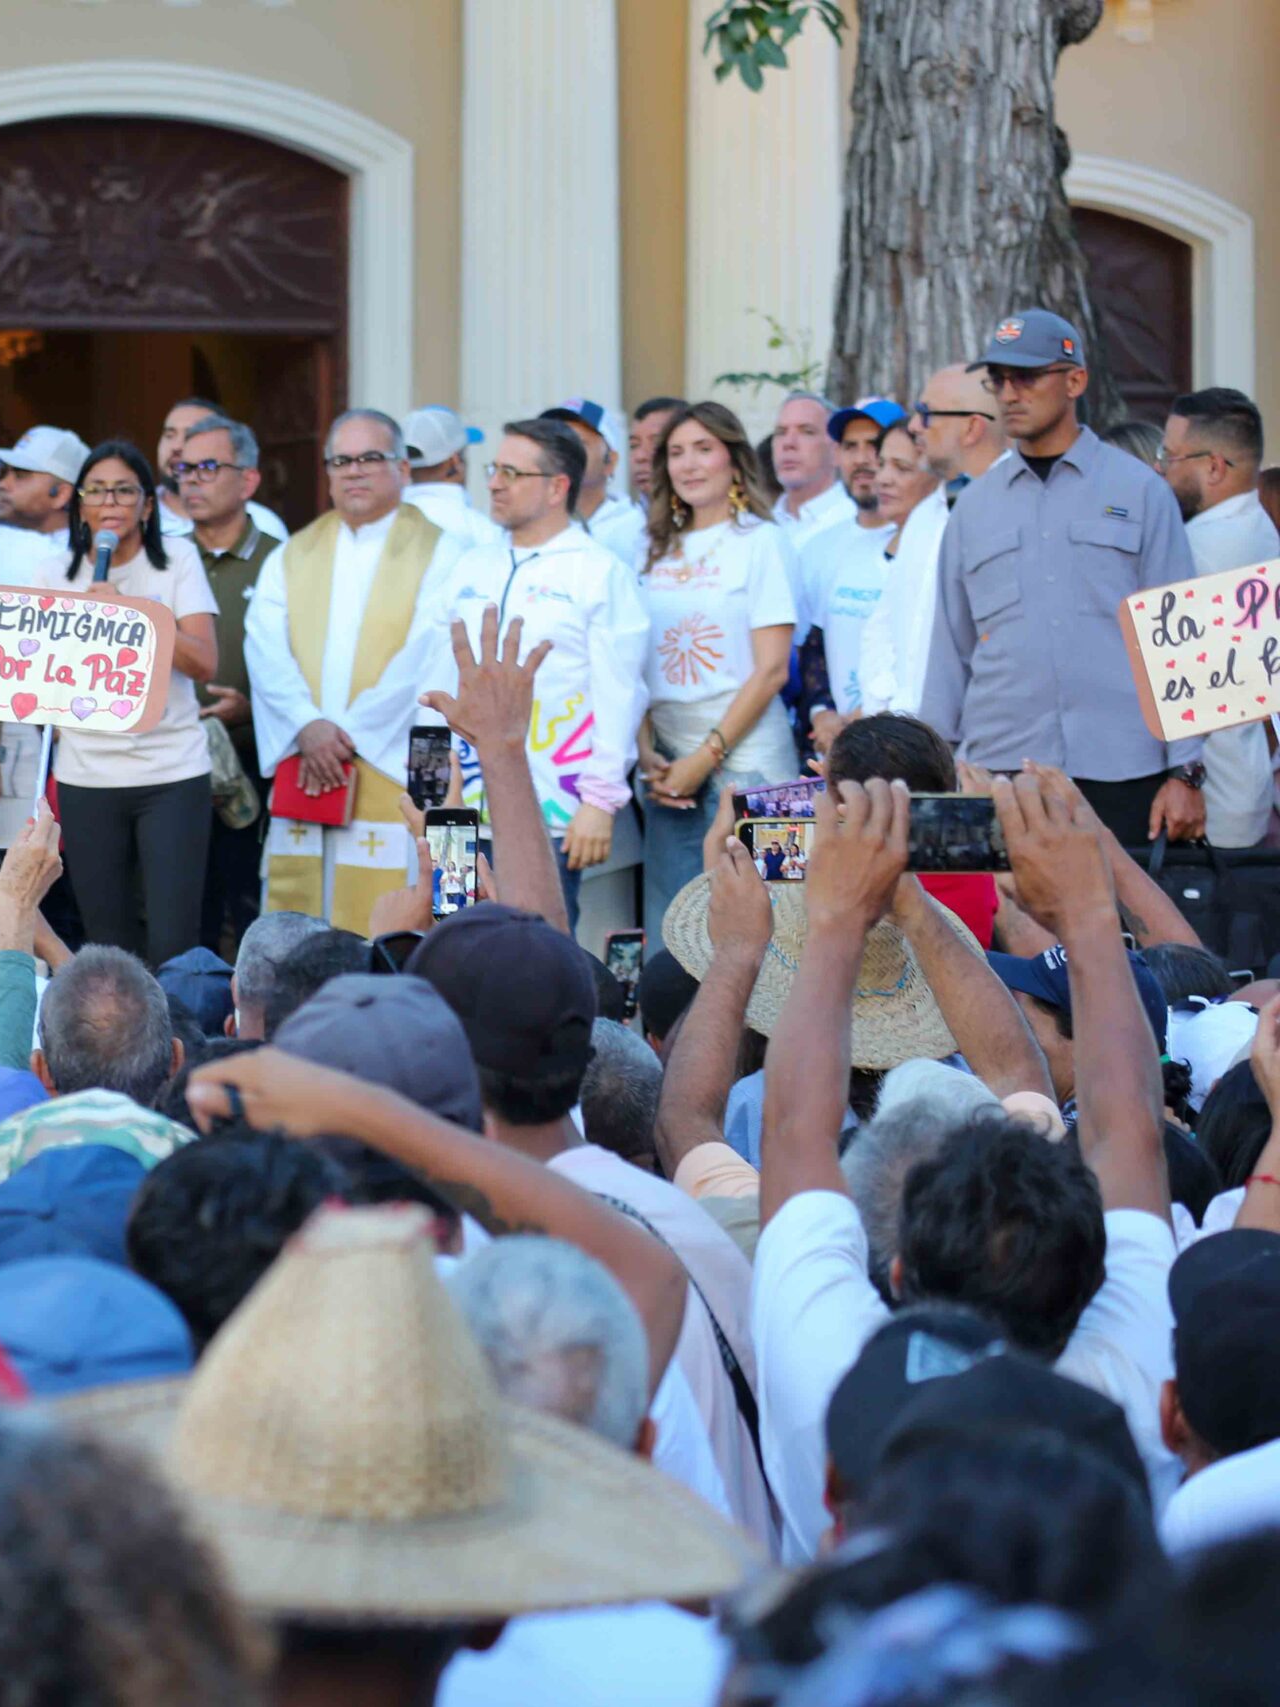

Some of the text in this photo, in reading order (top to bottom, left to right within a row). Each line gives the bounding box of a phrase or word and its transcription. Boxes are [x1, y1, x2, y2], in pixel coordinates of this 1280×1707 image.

[1151, 591, 1205, 647] La
[81, 653, 146, 697] Paz
[1161, 675, 1196, 702] es
[1206, 647, 1245, 690] el
